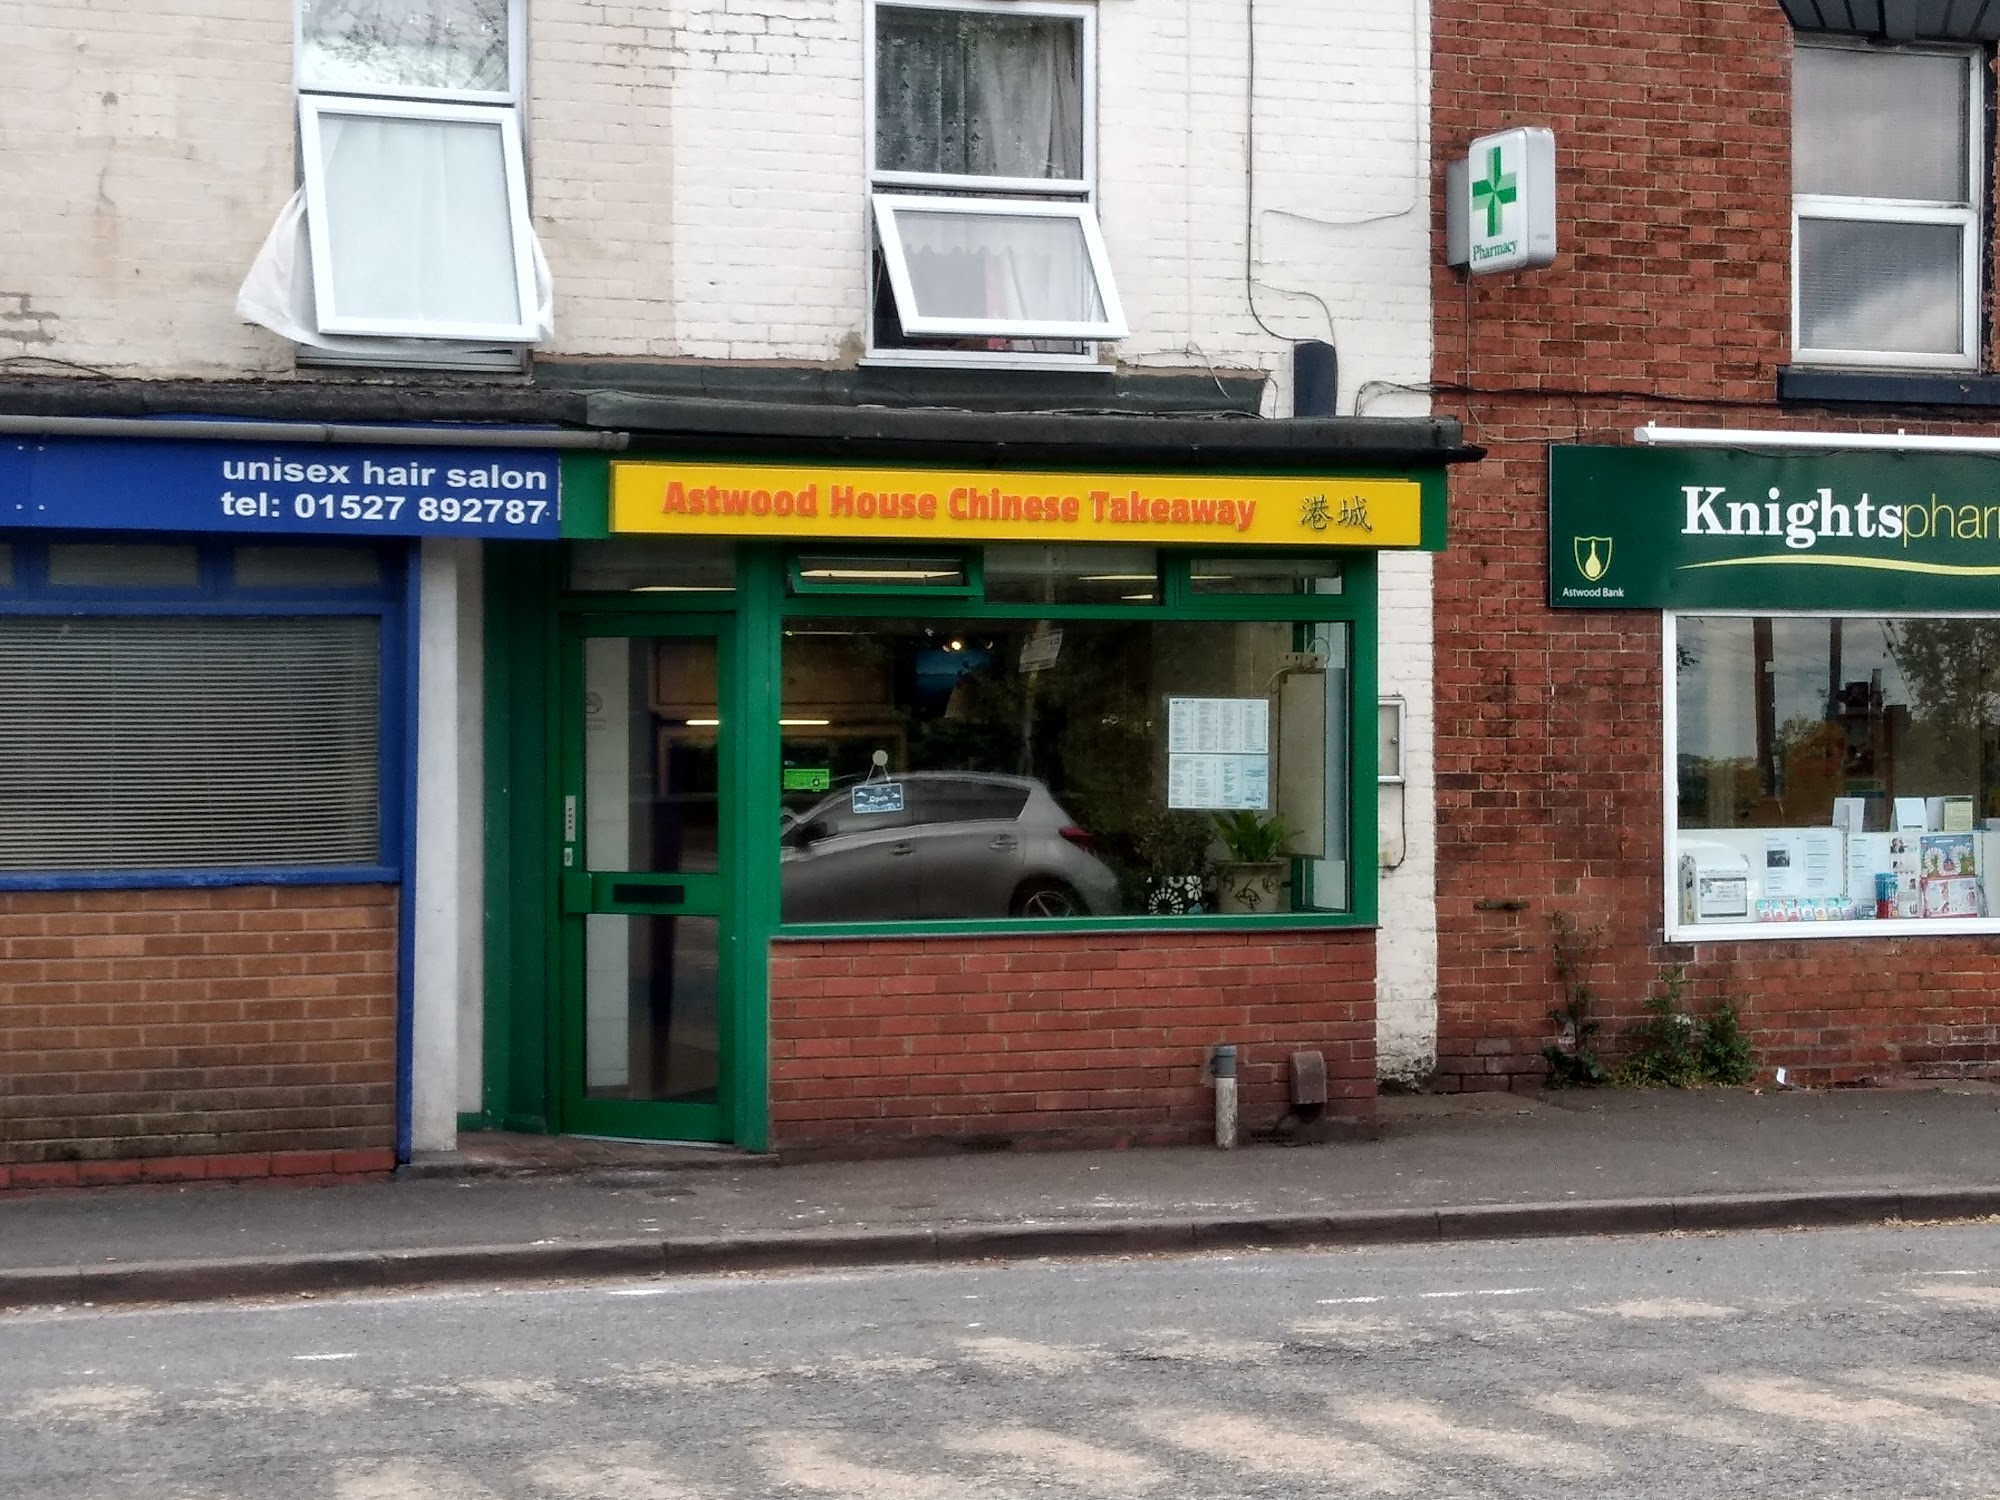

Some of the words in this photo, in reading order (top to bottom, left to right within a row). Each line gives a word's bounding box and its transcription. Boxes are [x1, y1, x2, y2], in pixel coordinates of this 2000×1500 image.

[1473, 240, 1517, 261] Pharmacy
[222, 457, 350, 484] unisex
[363, 462, 436, 487] hair
[446, 464, 547, 490] salon
[221, 491, 280, 518] tel:
[294, 493, 406, 521] 01527
[418, 497, 547, 525] 892787
[662, 480, 817, 518] Astwood
[829, 484, 938, 519] House
[947, 487, 1080, 522] Chinese
[1088, 489, 1257, 531] Takeaway
[1299, 494, 1374, 532] 港城
[1562, 587, 1601, 597] Astwood
[1602, 587, 1625, 597] Bank
